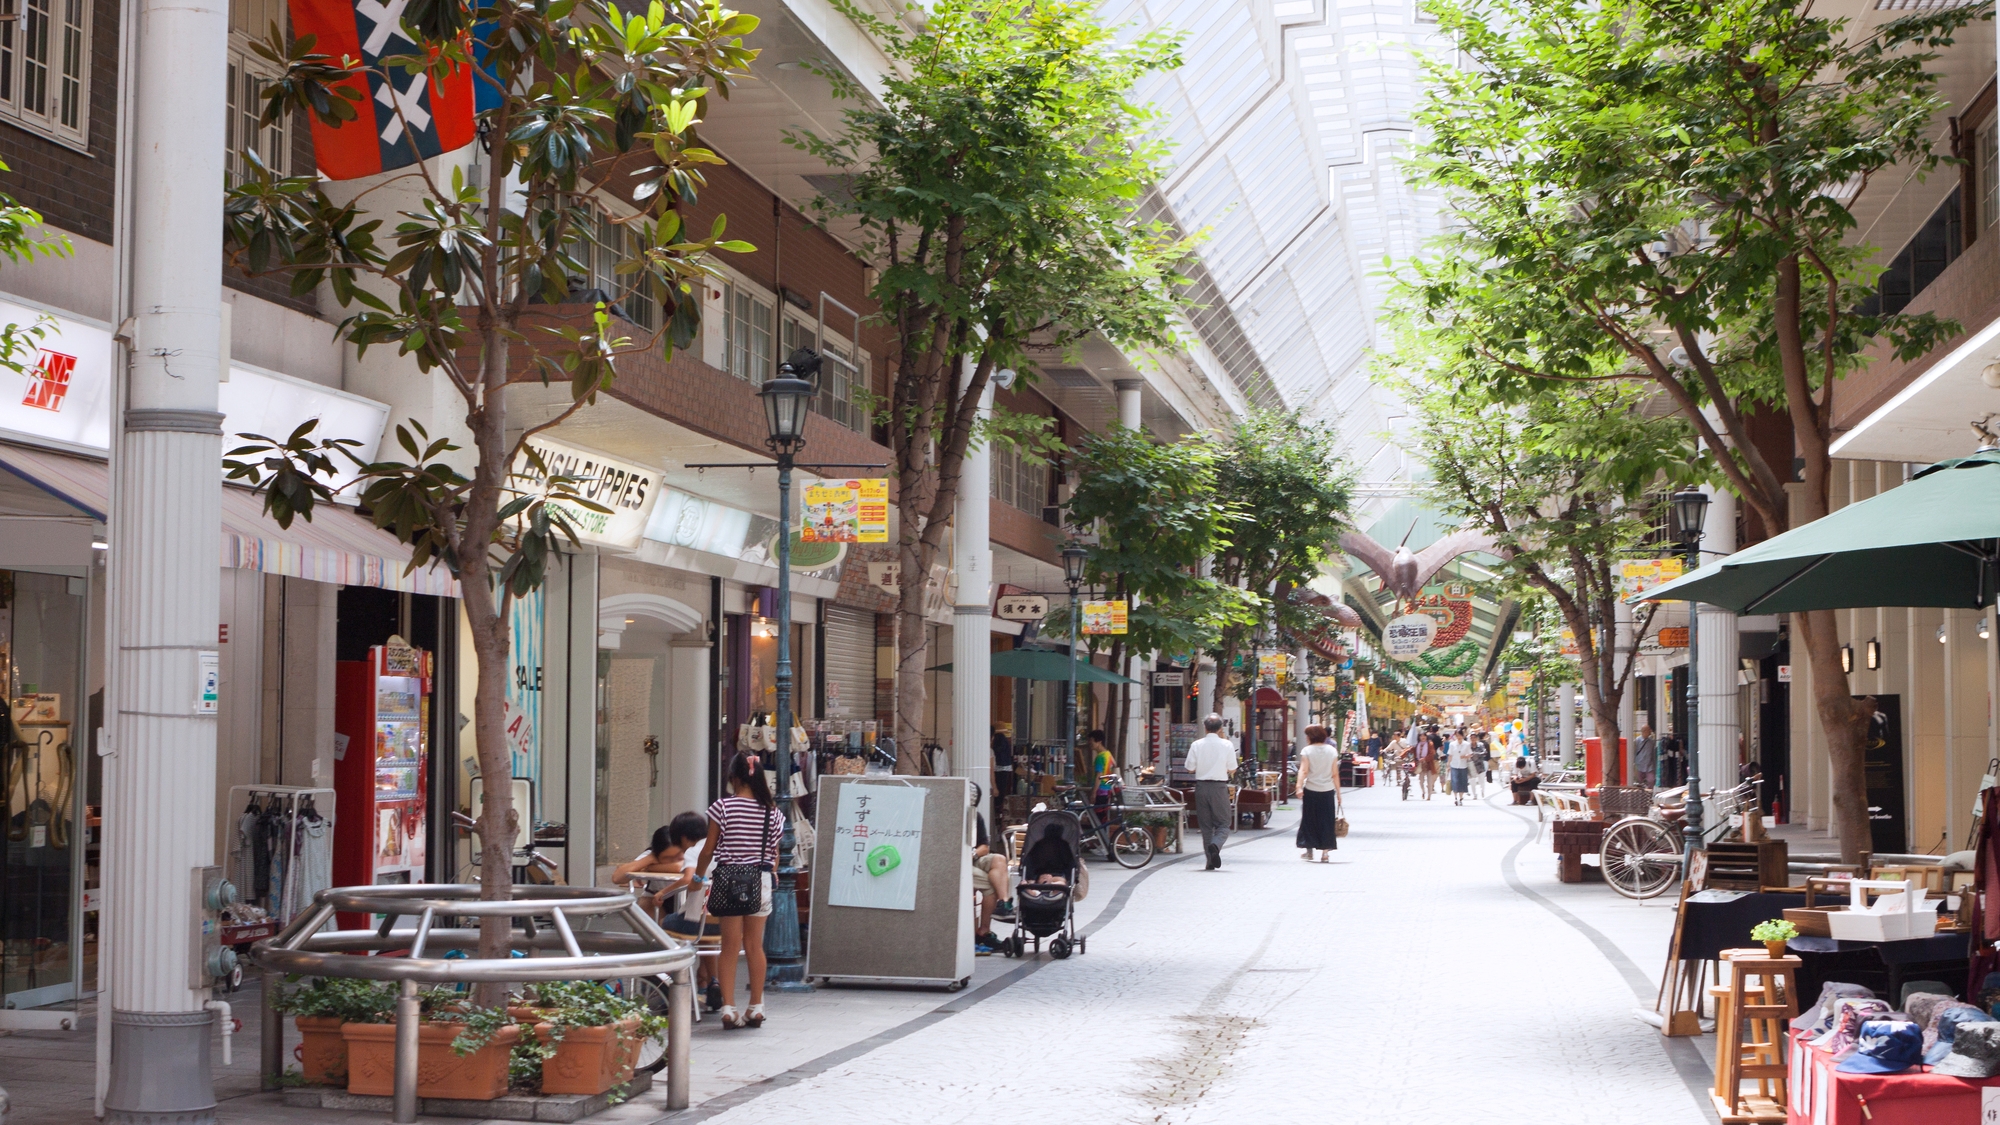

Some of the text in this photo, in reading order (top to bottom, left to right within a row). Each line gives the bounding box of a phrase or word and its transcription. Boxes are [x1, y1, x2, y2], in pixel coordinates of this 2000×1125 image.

[578, 461, 649, 511] PUPPIES
[582, 511, 609, 534] STORE
[1003, 604, 1041, 614] 須々木
[515, 665, 542, 692] SALE
